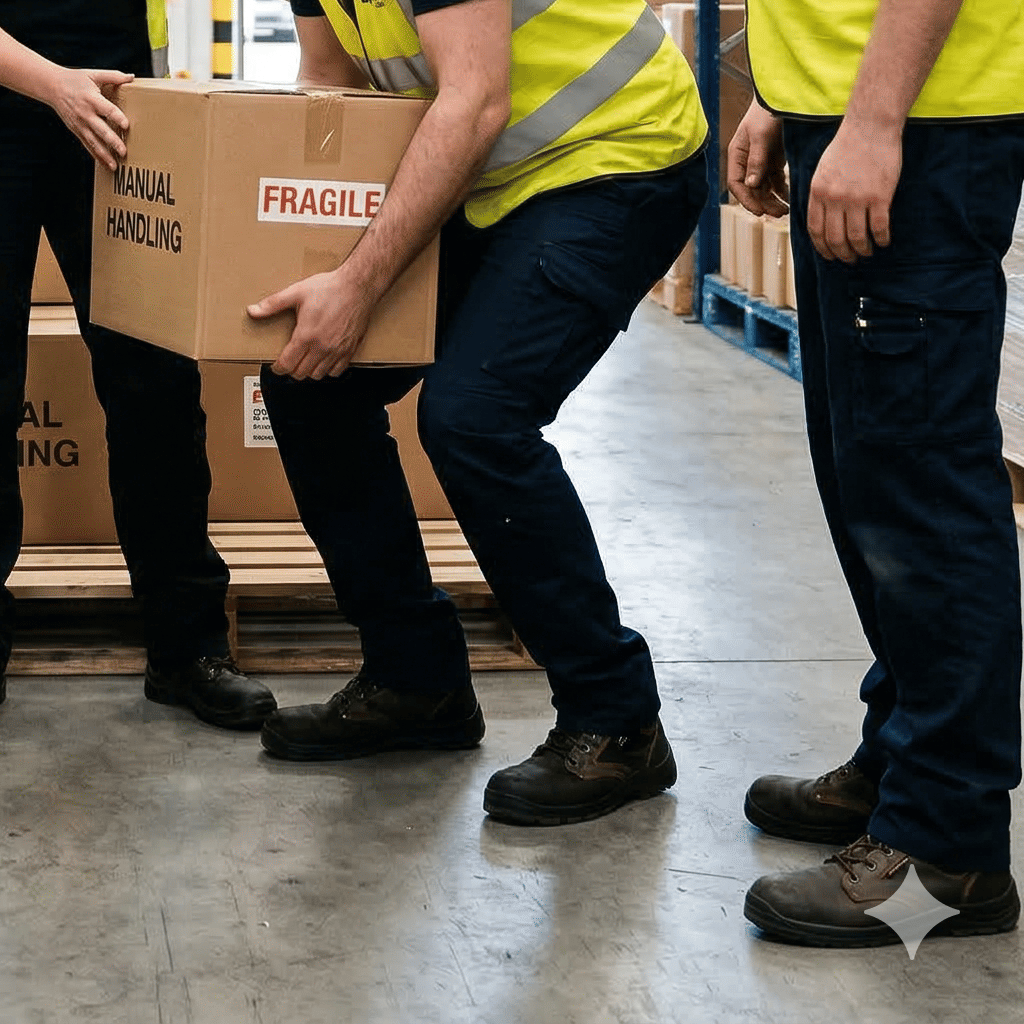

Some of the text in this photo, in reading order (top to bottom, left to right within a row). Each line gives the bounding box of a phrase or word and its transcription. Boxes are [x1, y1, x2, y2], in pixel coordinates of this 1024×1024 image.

[112, 164, 176, 207] MANUAL
[262, 184, 382, 219] FRAGILE
[106, 206, 183, 255] HANDLING
